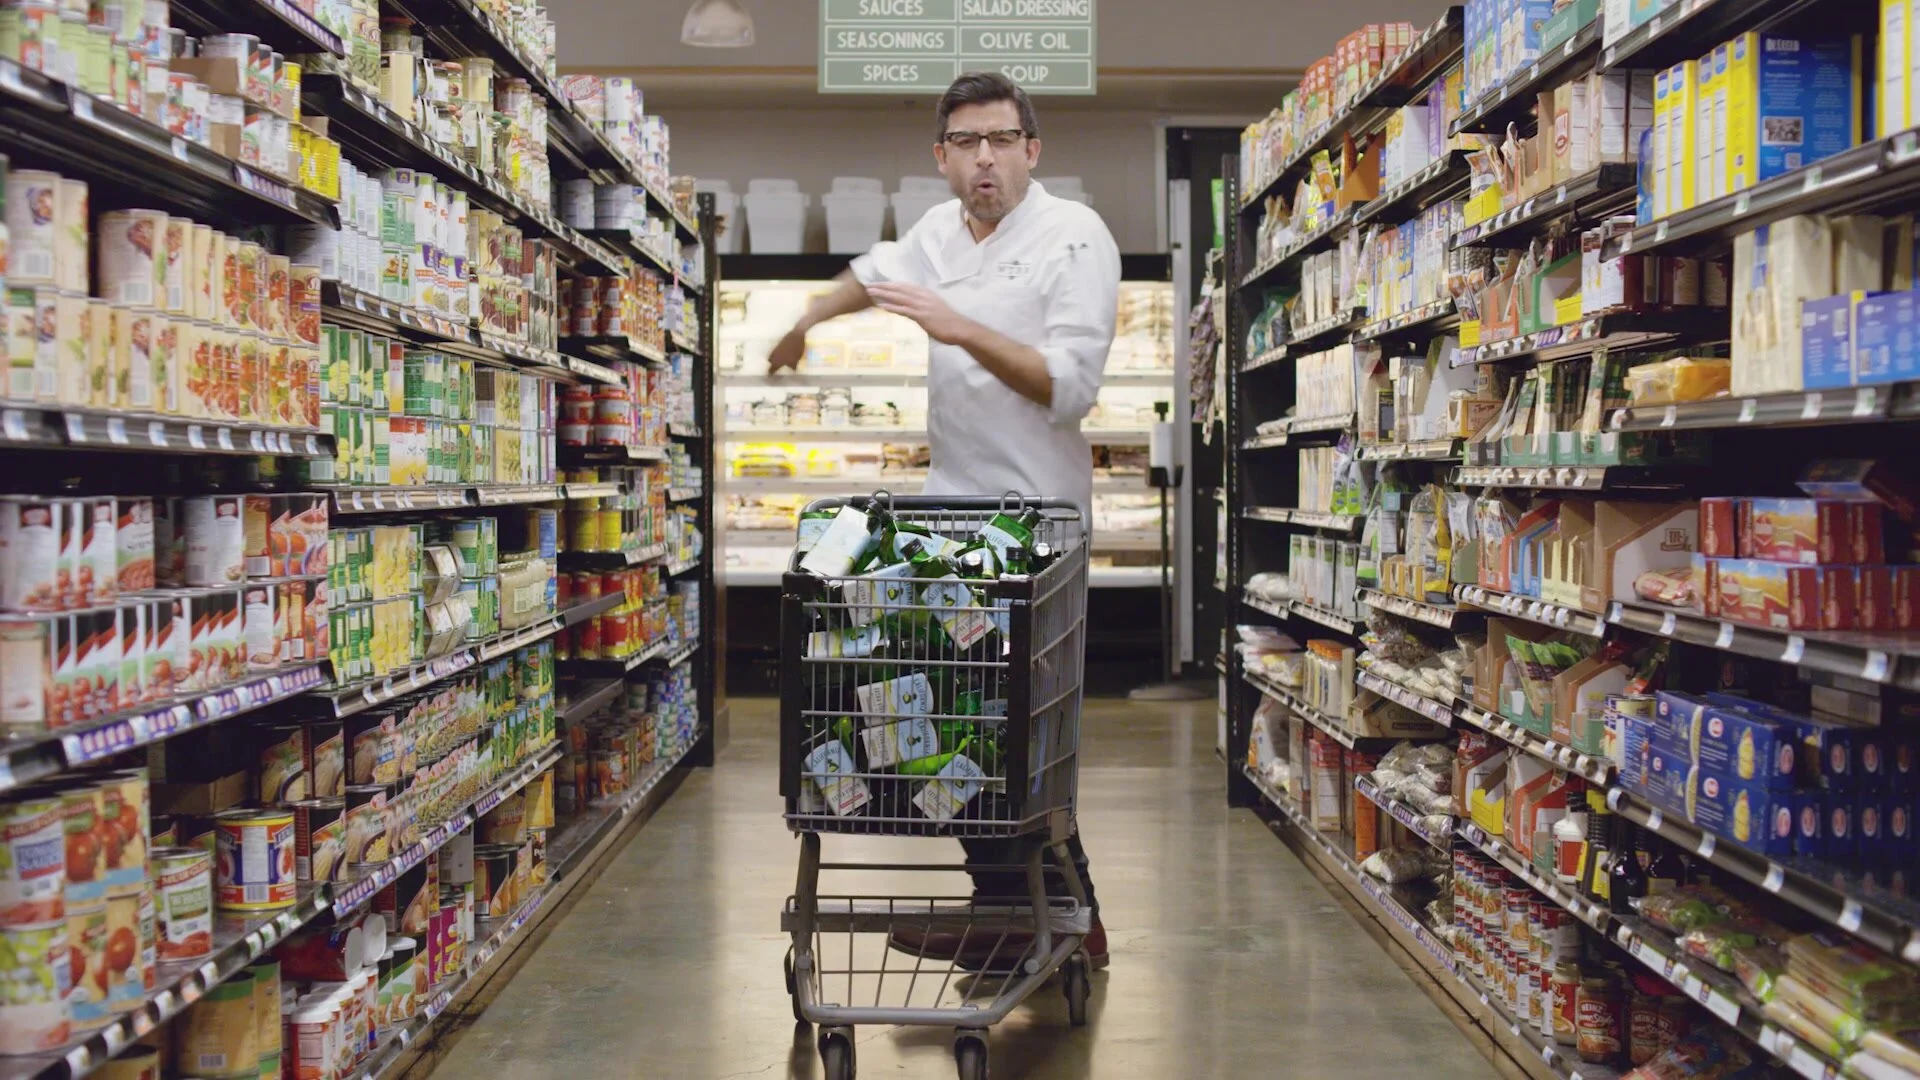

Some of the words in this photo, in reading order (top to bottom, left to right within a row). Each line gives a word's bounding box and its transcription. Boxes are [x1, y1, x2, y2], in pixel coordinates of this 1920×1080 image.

[859, 0, 924, 15] SAUCES
[963, 0, 1013, 16] SALAD
[1015, 0, 1089, 16] DRESSING
[837, 32, 944, 48] SEASONINGS
[979, 32, 1033, 49] OLIVE
[1040, 32, 1070, 49] OIL
[863, 65, 919, 82] SPICES
[1000, 65, 1048, 82] SOUP
